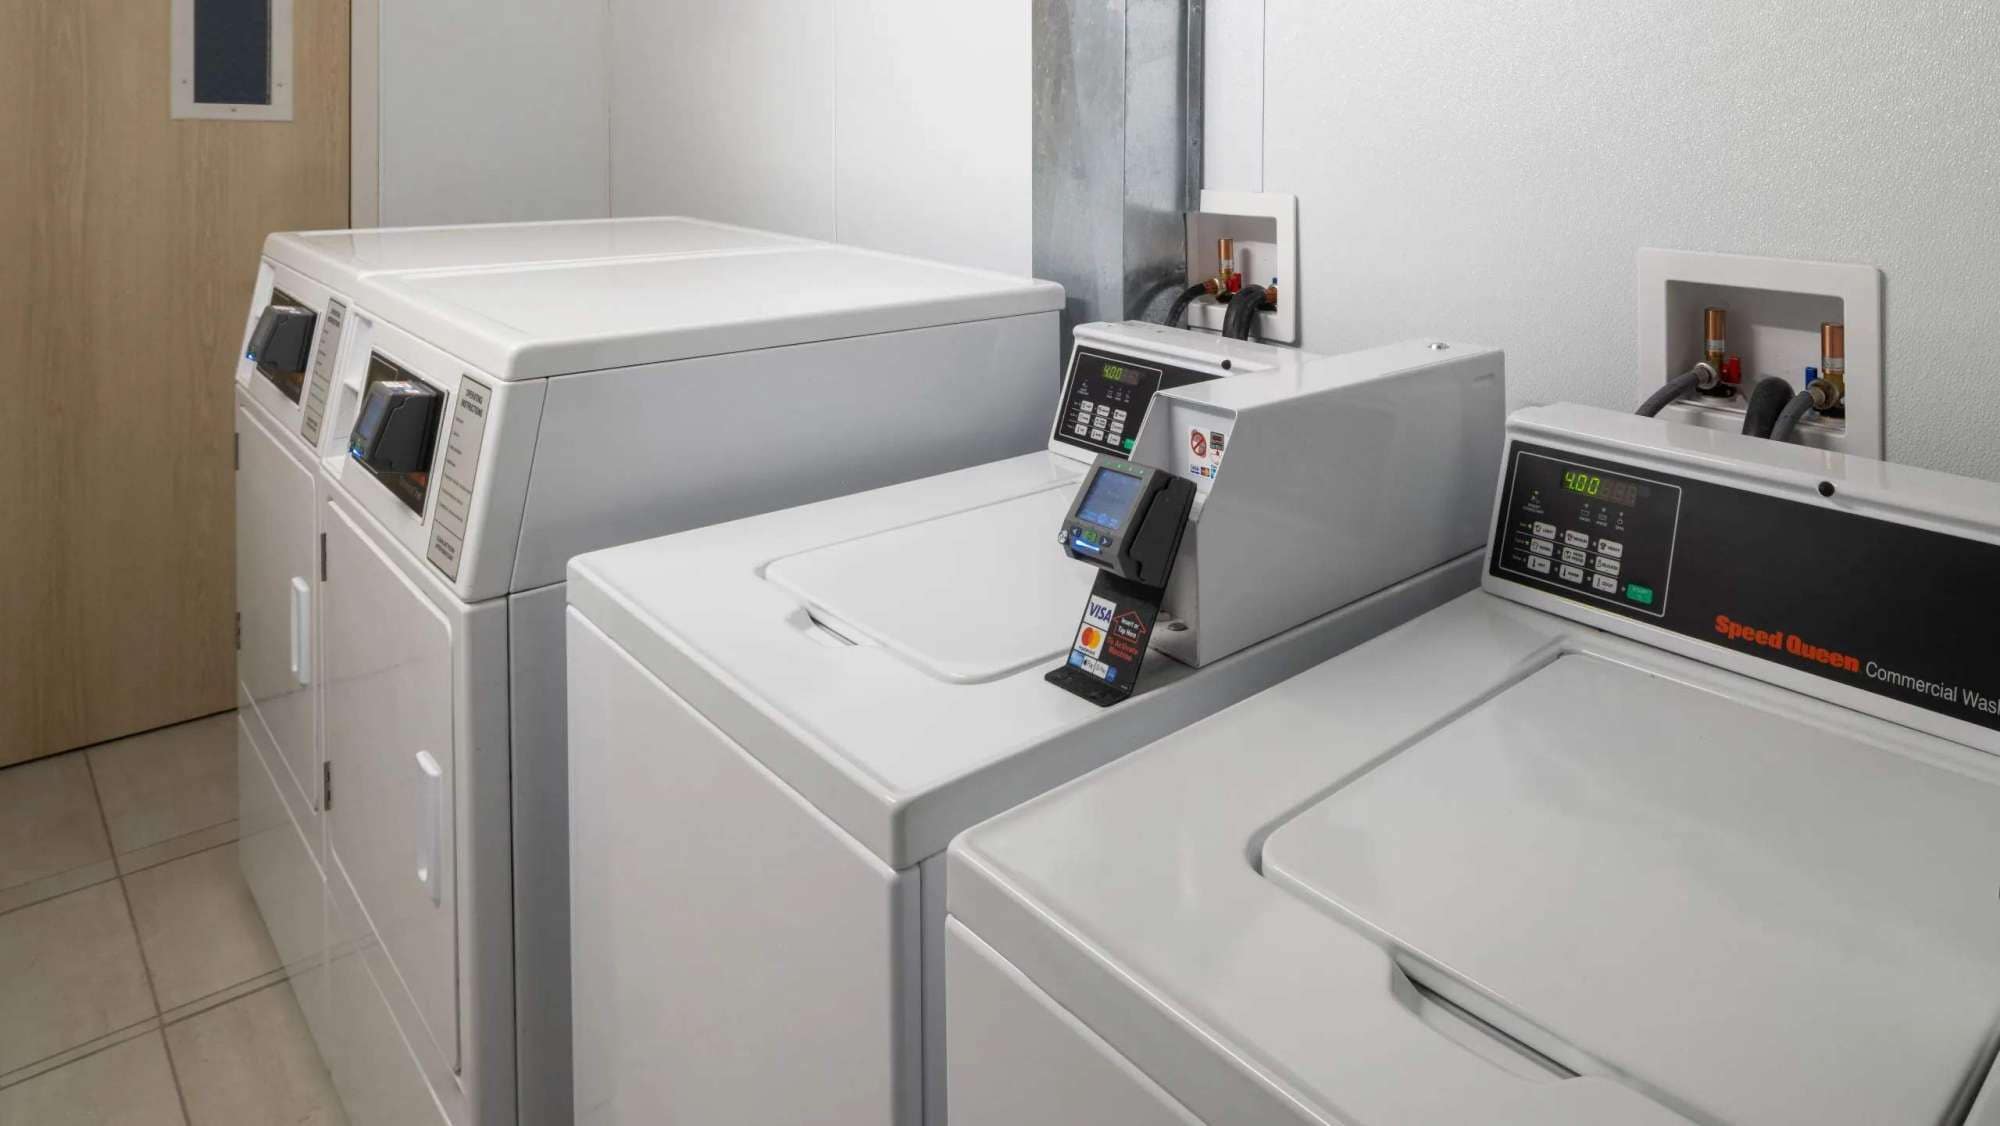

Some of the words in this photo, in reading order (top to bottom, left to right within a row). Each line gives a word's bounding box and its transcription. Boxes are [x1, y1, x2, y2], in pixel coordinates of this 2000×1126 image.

[1565, 472, 1600, 495] 4.00
[1089, 602, 1112, 622] VISA
[1715, 614, 1783, 651] Speed
[1786, 634, 1860, 673] Queen
[1865, 661, 1958, 702] Commercial
